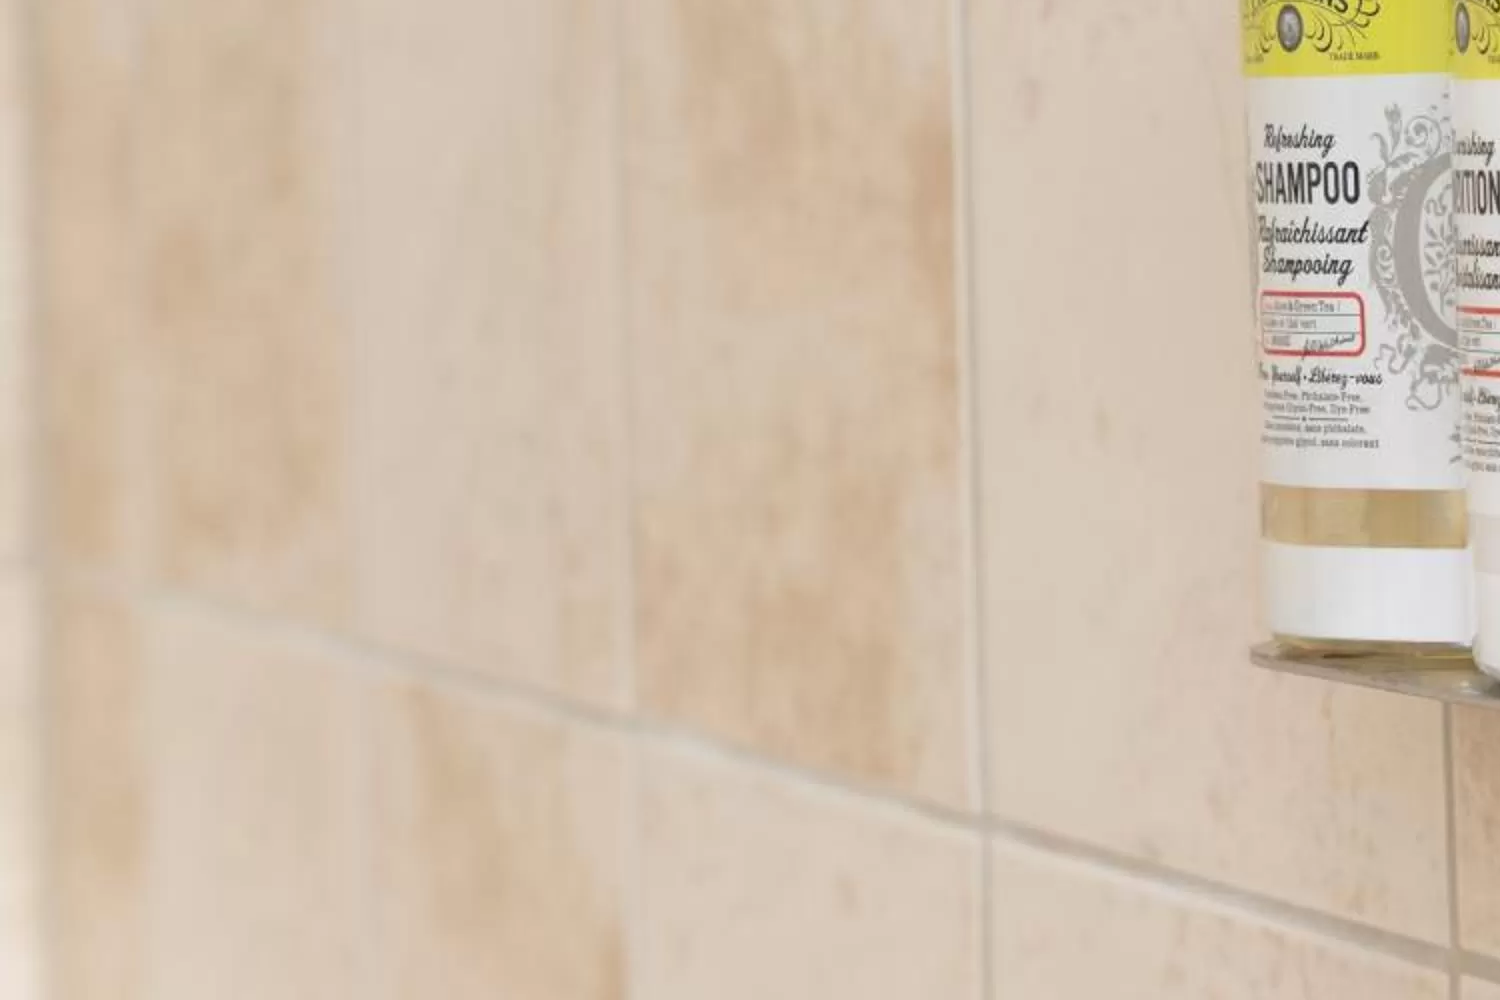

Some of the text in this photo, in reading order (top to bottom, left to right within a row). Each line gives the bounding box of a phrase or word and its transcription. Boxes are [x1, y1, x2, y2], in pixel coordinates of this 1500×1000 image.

[1264, 122, 1336, 159] Refreshing
[1256, 160, 1361, 205] SHAMPOO
[1263, 246, 1354, 287] Shampooing
